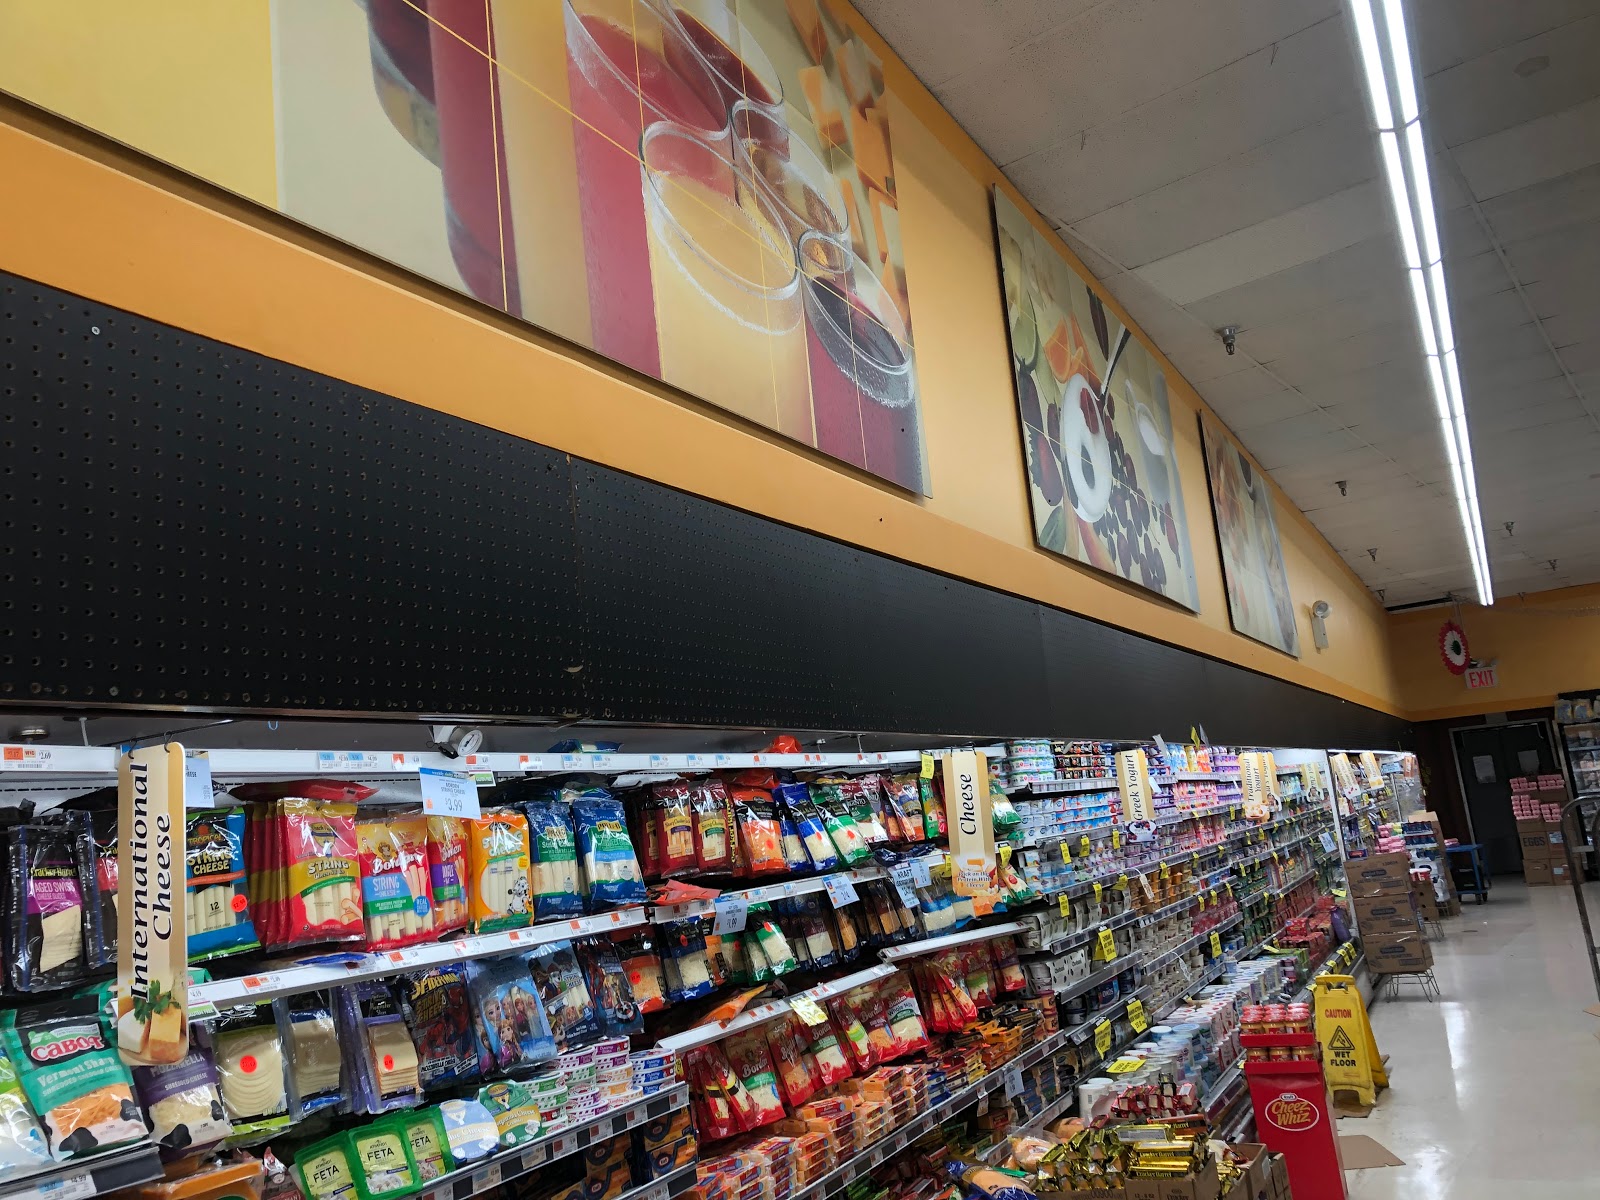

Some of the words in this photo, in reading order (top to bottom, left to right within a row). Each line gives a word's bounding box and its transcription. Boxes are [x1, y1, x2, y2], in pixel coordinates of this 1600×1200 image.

[1468, 669, 1495, 688] EXIT
[1125, 755, 1138, 788] Yogurt
[1243, 758, 1255, 802] Traditional
[1254, 768, 1262, 792] Yogurt
[445, 798, 463, 811] $3.99
[960, 774, 977, 835] Cheese
[1130, 791, 1144, 821] Greek
[1522, 836, 1546, 847] EGGS
[193, 860, 231, 875] CHEESE
[308, 860, 350, 875] STRING
[130, 762, 150, 1002] International
[151, 813, 171, 941] Cheese
[373, 876, 400, 891] STRING
[34, 881, 52, 893] AGED
[53, 881, 75, 893] SWISS
[210, 901, 220, 911] 12
[1325, 1009, 1352, 1018] CAUTION
[1330, 1059, 1357, 1067] FLOOR
[37, 1065, 85, 1087] Vermont
[84, 1057, 115, 1070] Sharp
[42, 1076, 78, 1097] SHREDDED
[517, 1108, 535, 1117] Cheese
[1271, 1101, 1311, 1115] Cheez
[1276, 1110, 1311, 1126] Whiz
[461, 1126, 491, 1137] Cheese
[410, 1135, 432, 1149] FETA
[366, 1147, 395, 1162] FETA
[71, 1174, 87, 1184] $4.99
[313, 1165, 340, 1183] FETA
